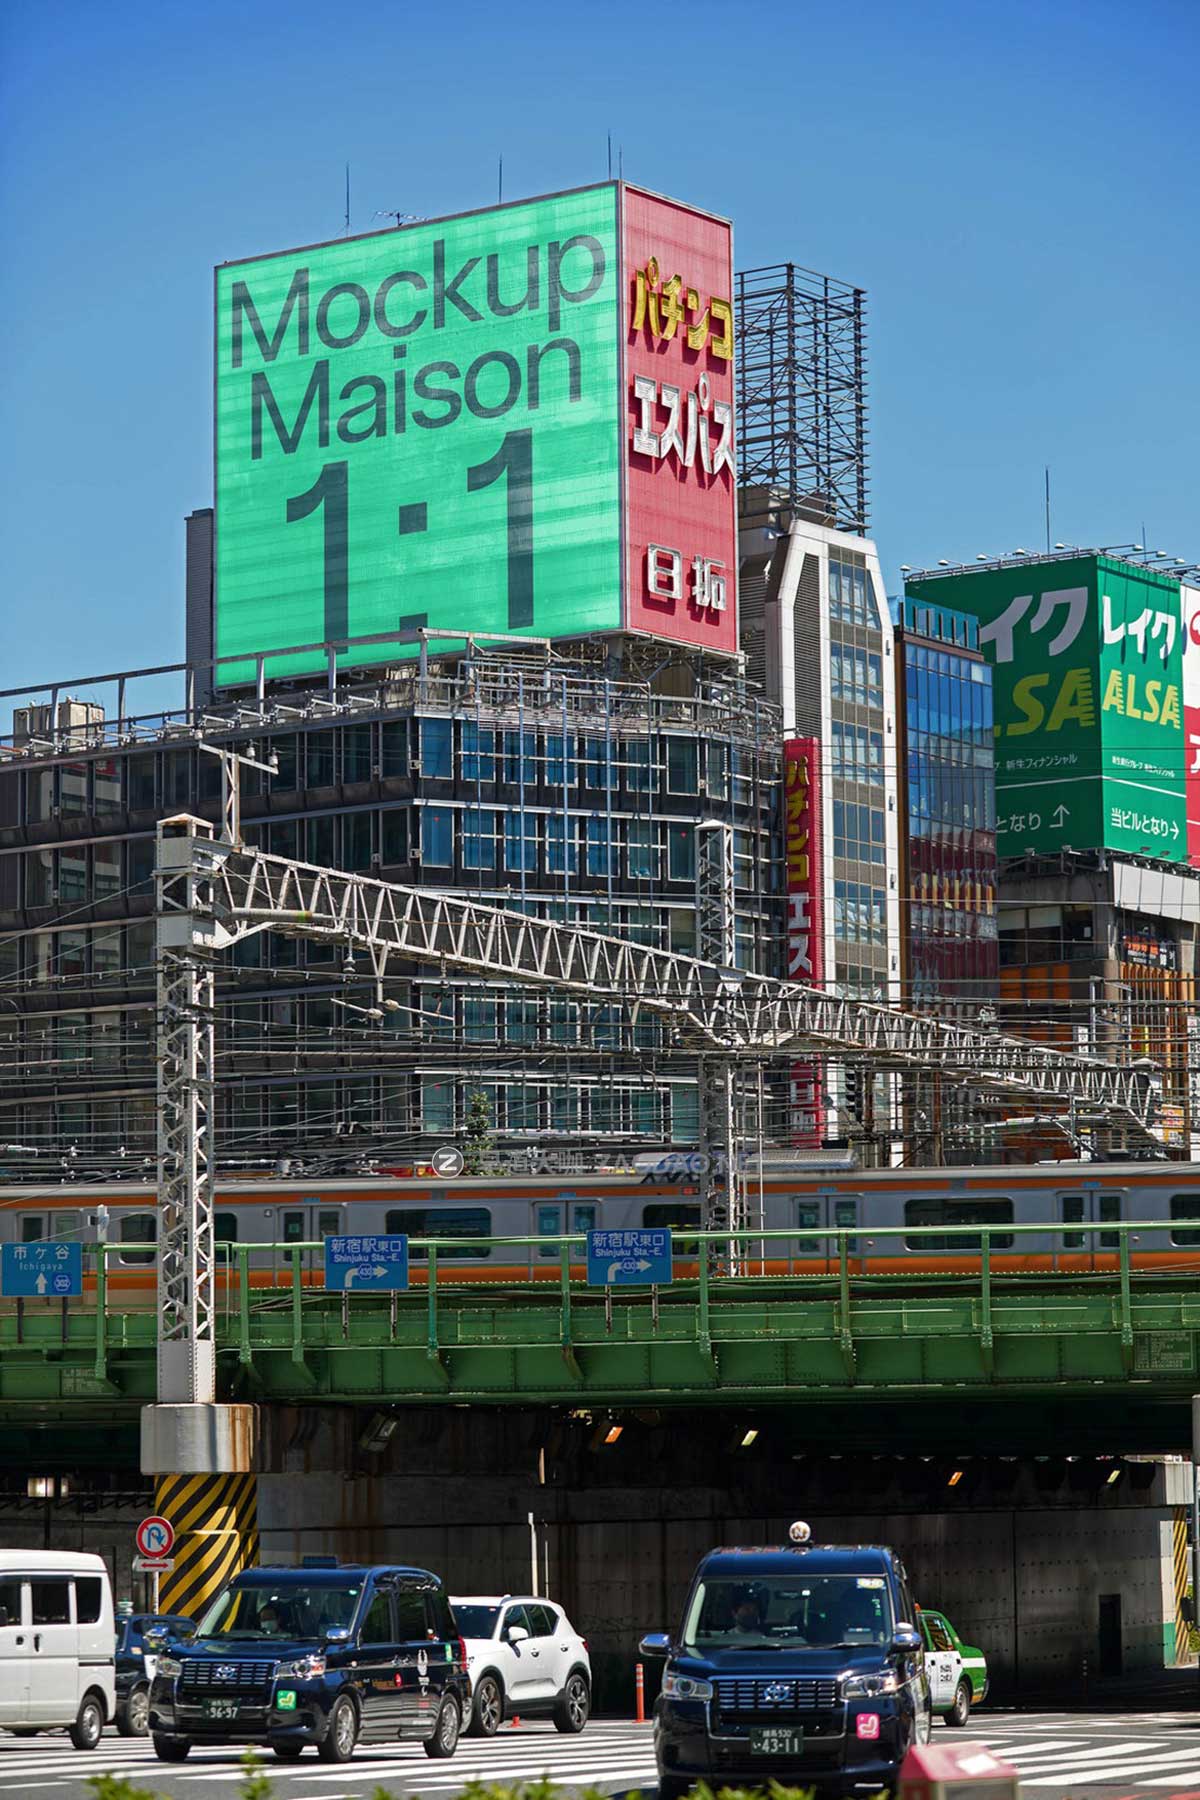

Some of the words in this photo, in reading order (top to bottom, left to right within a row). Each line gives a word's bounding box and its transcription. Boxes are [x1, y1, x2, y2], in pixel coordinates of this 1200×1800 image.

[231, 235, 605, 368] Mockup
[633, 255, 733, 360] パチンコ
[251, 337, 582, 459] Maison
[633, 371, 736, 480] エスパス
[287, 428, 534, 656] 1:1
[980, 587, 1088, 663] イク
[1102, 595, 1176, 660] レイク
[994, 668, 1095, 737] SA
[1102, 669, 1180, 729] ALSA
[787, 757, 810, 882] パチンコ
[995, 813, 1041, 833] となり
[1111, 807, 1169, 837] 当ビルとなり
[20, 1262, 63, 1271] Ichigaya
[331, 1238, 401, 1253] 新宿駅東口
[334, 1254, 369, 1263] Shinjuku
[592, 1231, 664, 1247] 新宿駅東口
[595, 1247, 631, 1258] Shinjuku
